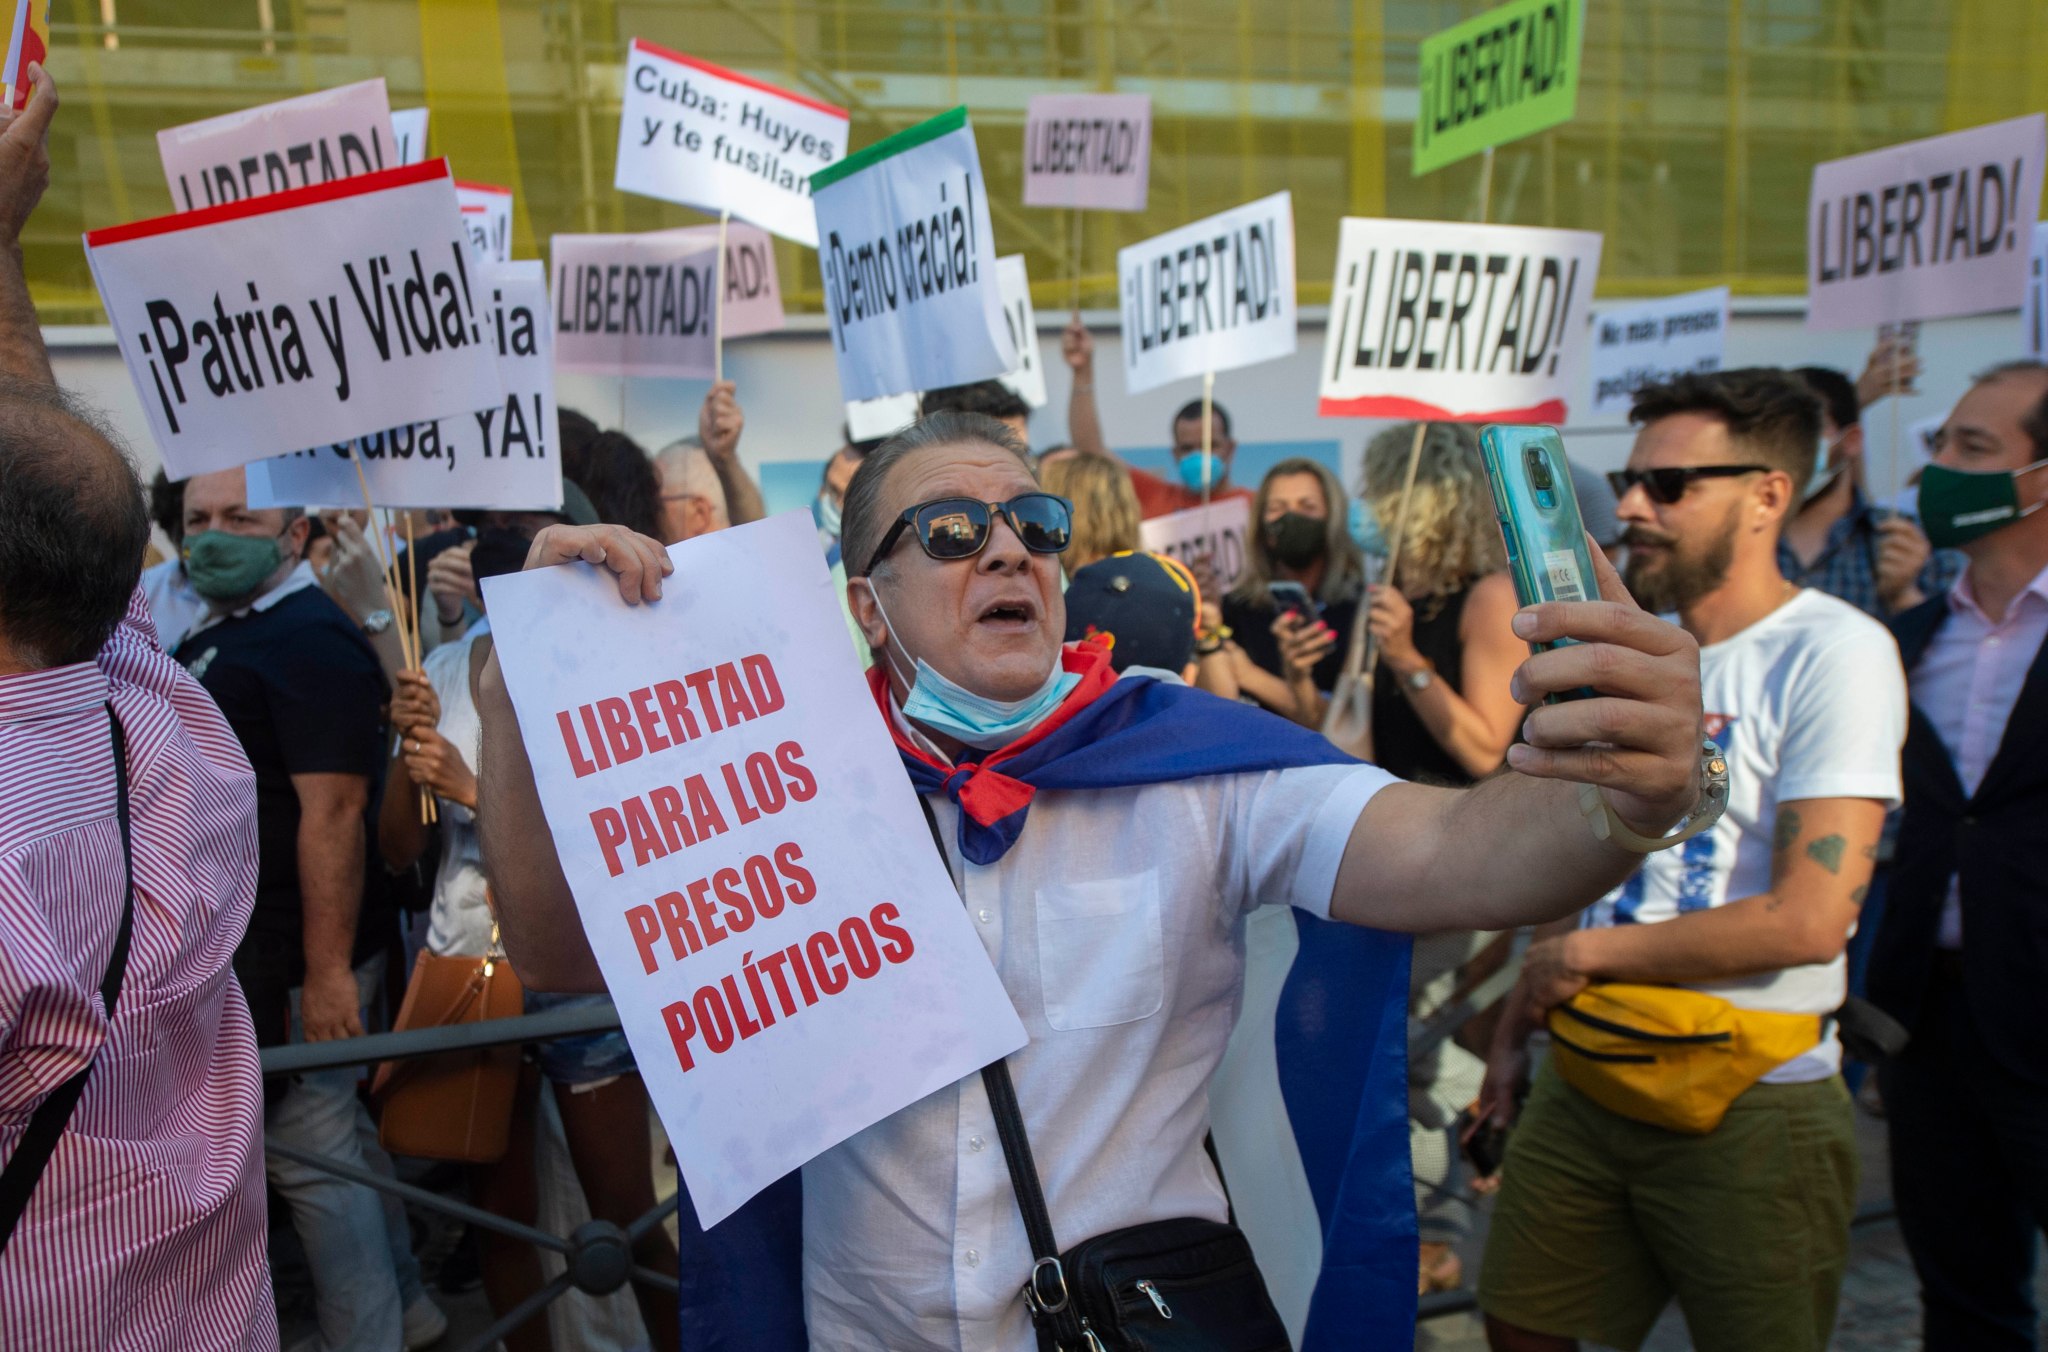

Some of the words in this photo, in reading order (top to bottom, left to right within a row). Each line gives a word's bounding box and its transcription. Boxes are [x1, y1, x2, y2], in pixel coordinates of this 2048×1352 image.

[634, 63, 729, 122] Cuba:
[740, 101, 835, 163] Huyes
[641, 115, 663, 146] y
[672, 120, 703, 153] te
[1031, 118, 1141, 175] LIBERTAD!
[1818, 157, 2023, 284] LIBERTAD!
[138, 280, 314, 434] ¡Patria
[308, 295, 350, 402] y
[342, 240, 481, 362] Vida!
[557, 263, 713, 336] LIBERTAD!
[1127, 217, 1281, 368] ¡LIBERTAD!
[1332, 249, 1579, 383] ¡LIBERTAD!
[474, 392, 546, 459] YA!
[556, 654, 786, 778] LIBERTAD
[589, 774, 728, 877] PARA
[721, 741, 818, 827] LOS
[624, 842, 818, 976] PRESOS
[660, 902, 915, 1073] POLÍTICOS
